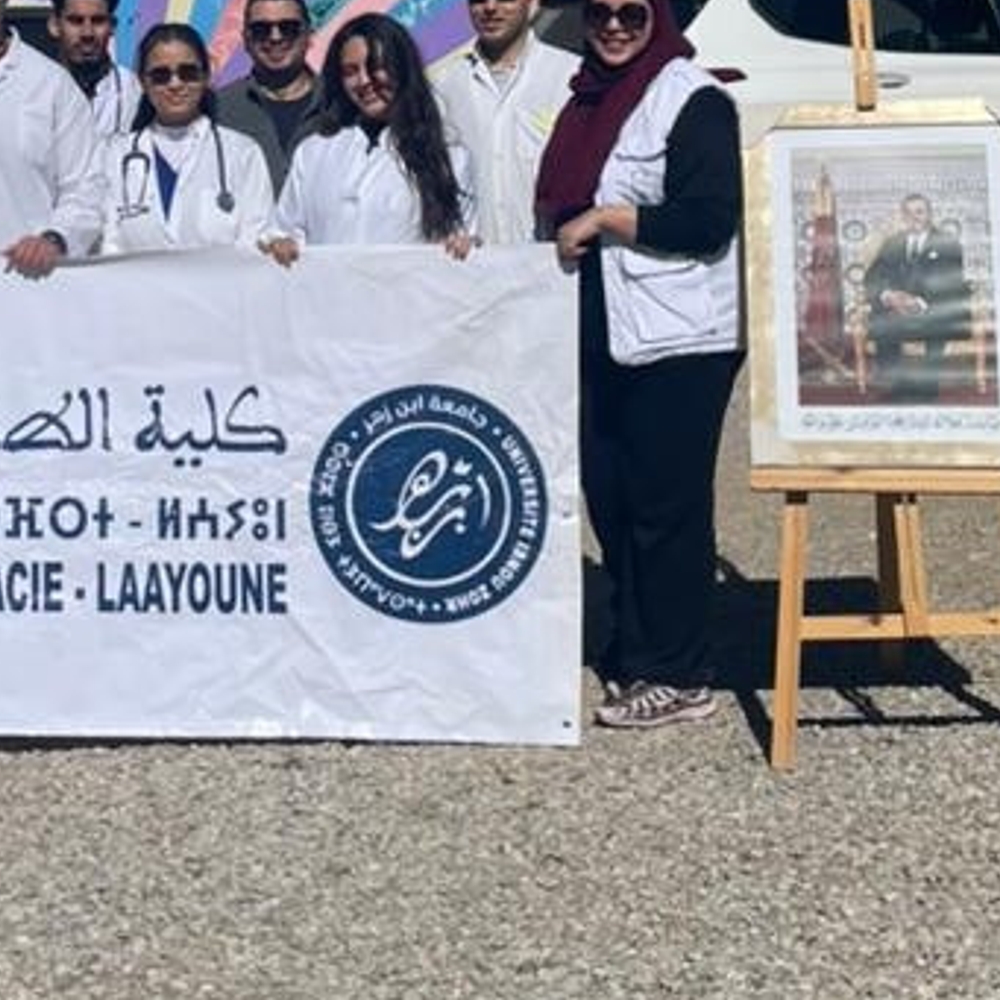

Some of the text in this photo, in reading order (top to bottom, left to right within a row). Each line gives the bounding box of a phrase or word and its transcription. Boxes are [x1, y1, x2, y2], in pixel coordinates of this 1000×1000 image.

[134, 384, 287, 468] كلية
[394, 392, 424, 419] ابن
[427, 393, 489, 430] جامعة
[97, 561, 288, 615] LAAYOUNE
